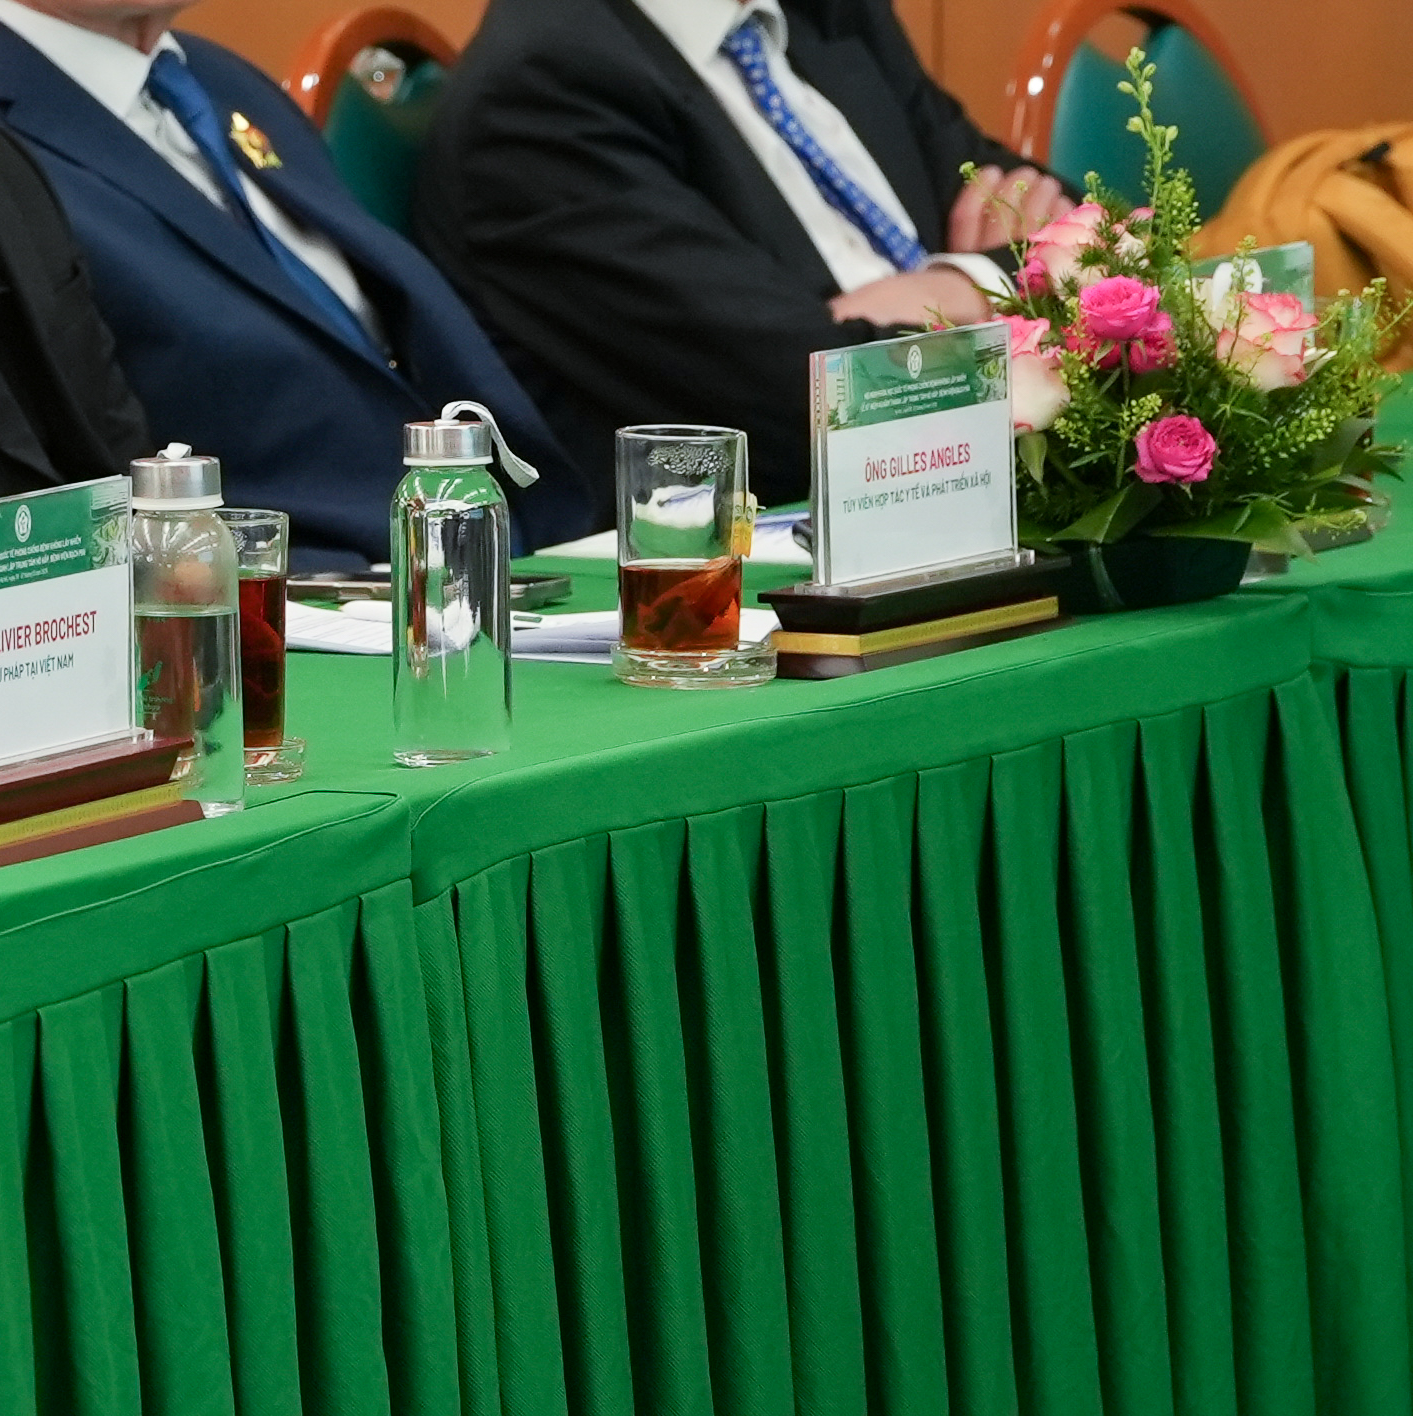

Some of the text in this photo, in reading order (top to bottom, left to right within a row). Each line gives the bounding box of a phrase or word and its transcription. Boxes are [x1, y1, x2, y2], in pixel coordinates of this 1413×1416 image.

[865, 443, 971, 483] ÔNG GILLES ANGLES
[905, 488, 911, 502] Y
[34, 610, 97, 646] BROCHEST
[4, 661, 24, 682] PHÁP
[25, 660, 39, 680] TẠI
[40, 654, 55, 677] VIỆT
[57, 652, 74, 671] NAM
